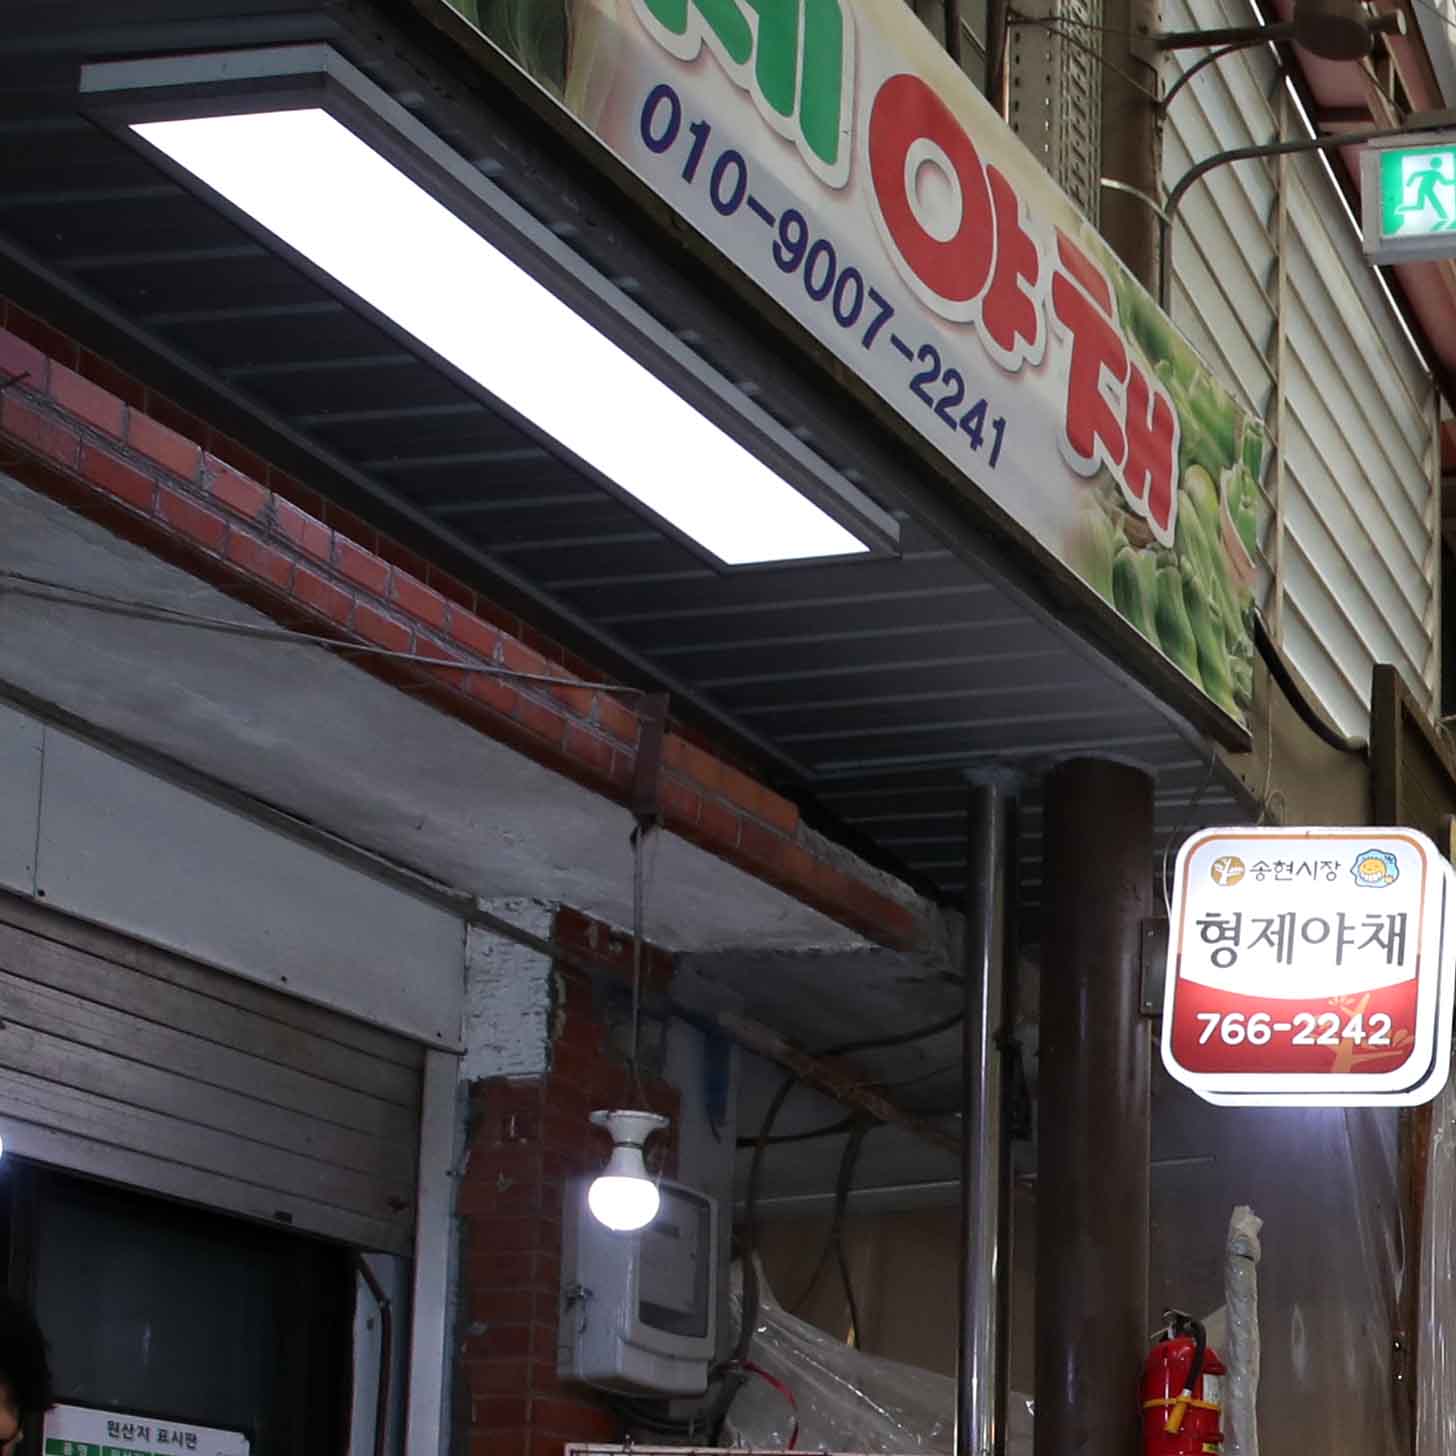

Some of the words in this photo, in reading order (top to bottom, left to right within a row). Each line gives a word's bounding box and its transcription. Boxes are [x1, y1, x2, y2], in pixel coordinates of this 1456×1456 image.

[640, 83, 1007, 470] 010-9007-2241
[1248, 857, 1341, 884] 송현시장
[1195, 909, 1408, 969] 형제야채
[1196, 1012, 1392, 1047] 766-2242
[107, 1420, 150, 1442] 원산지
[155, 1427, 198, 1449] 표시판
